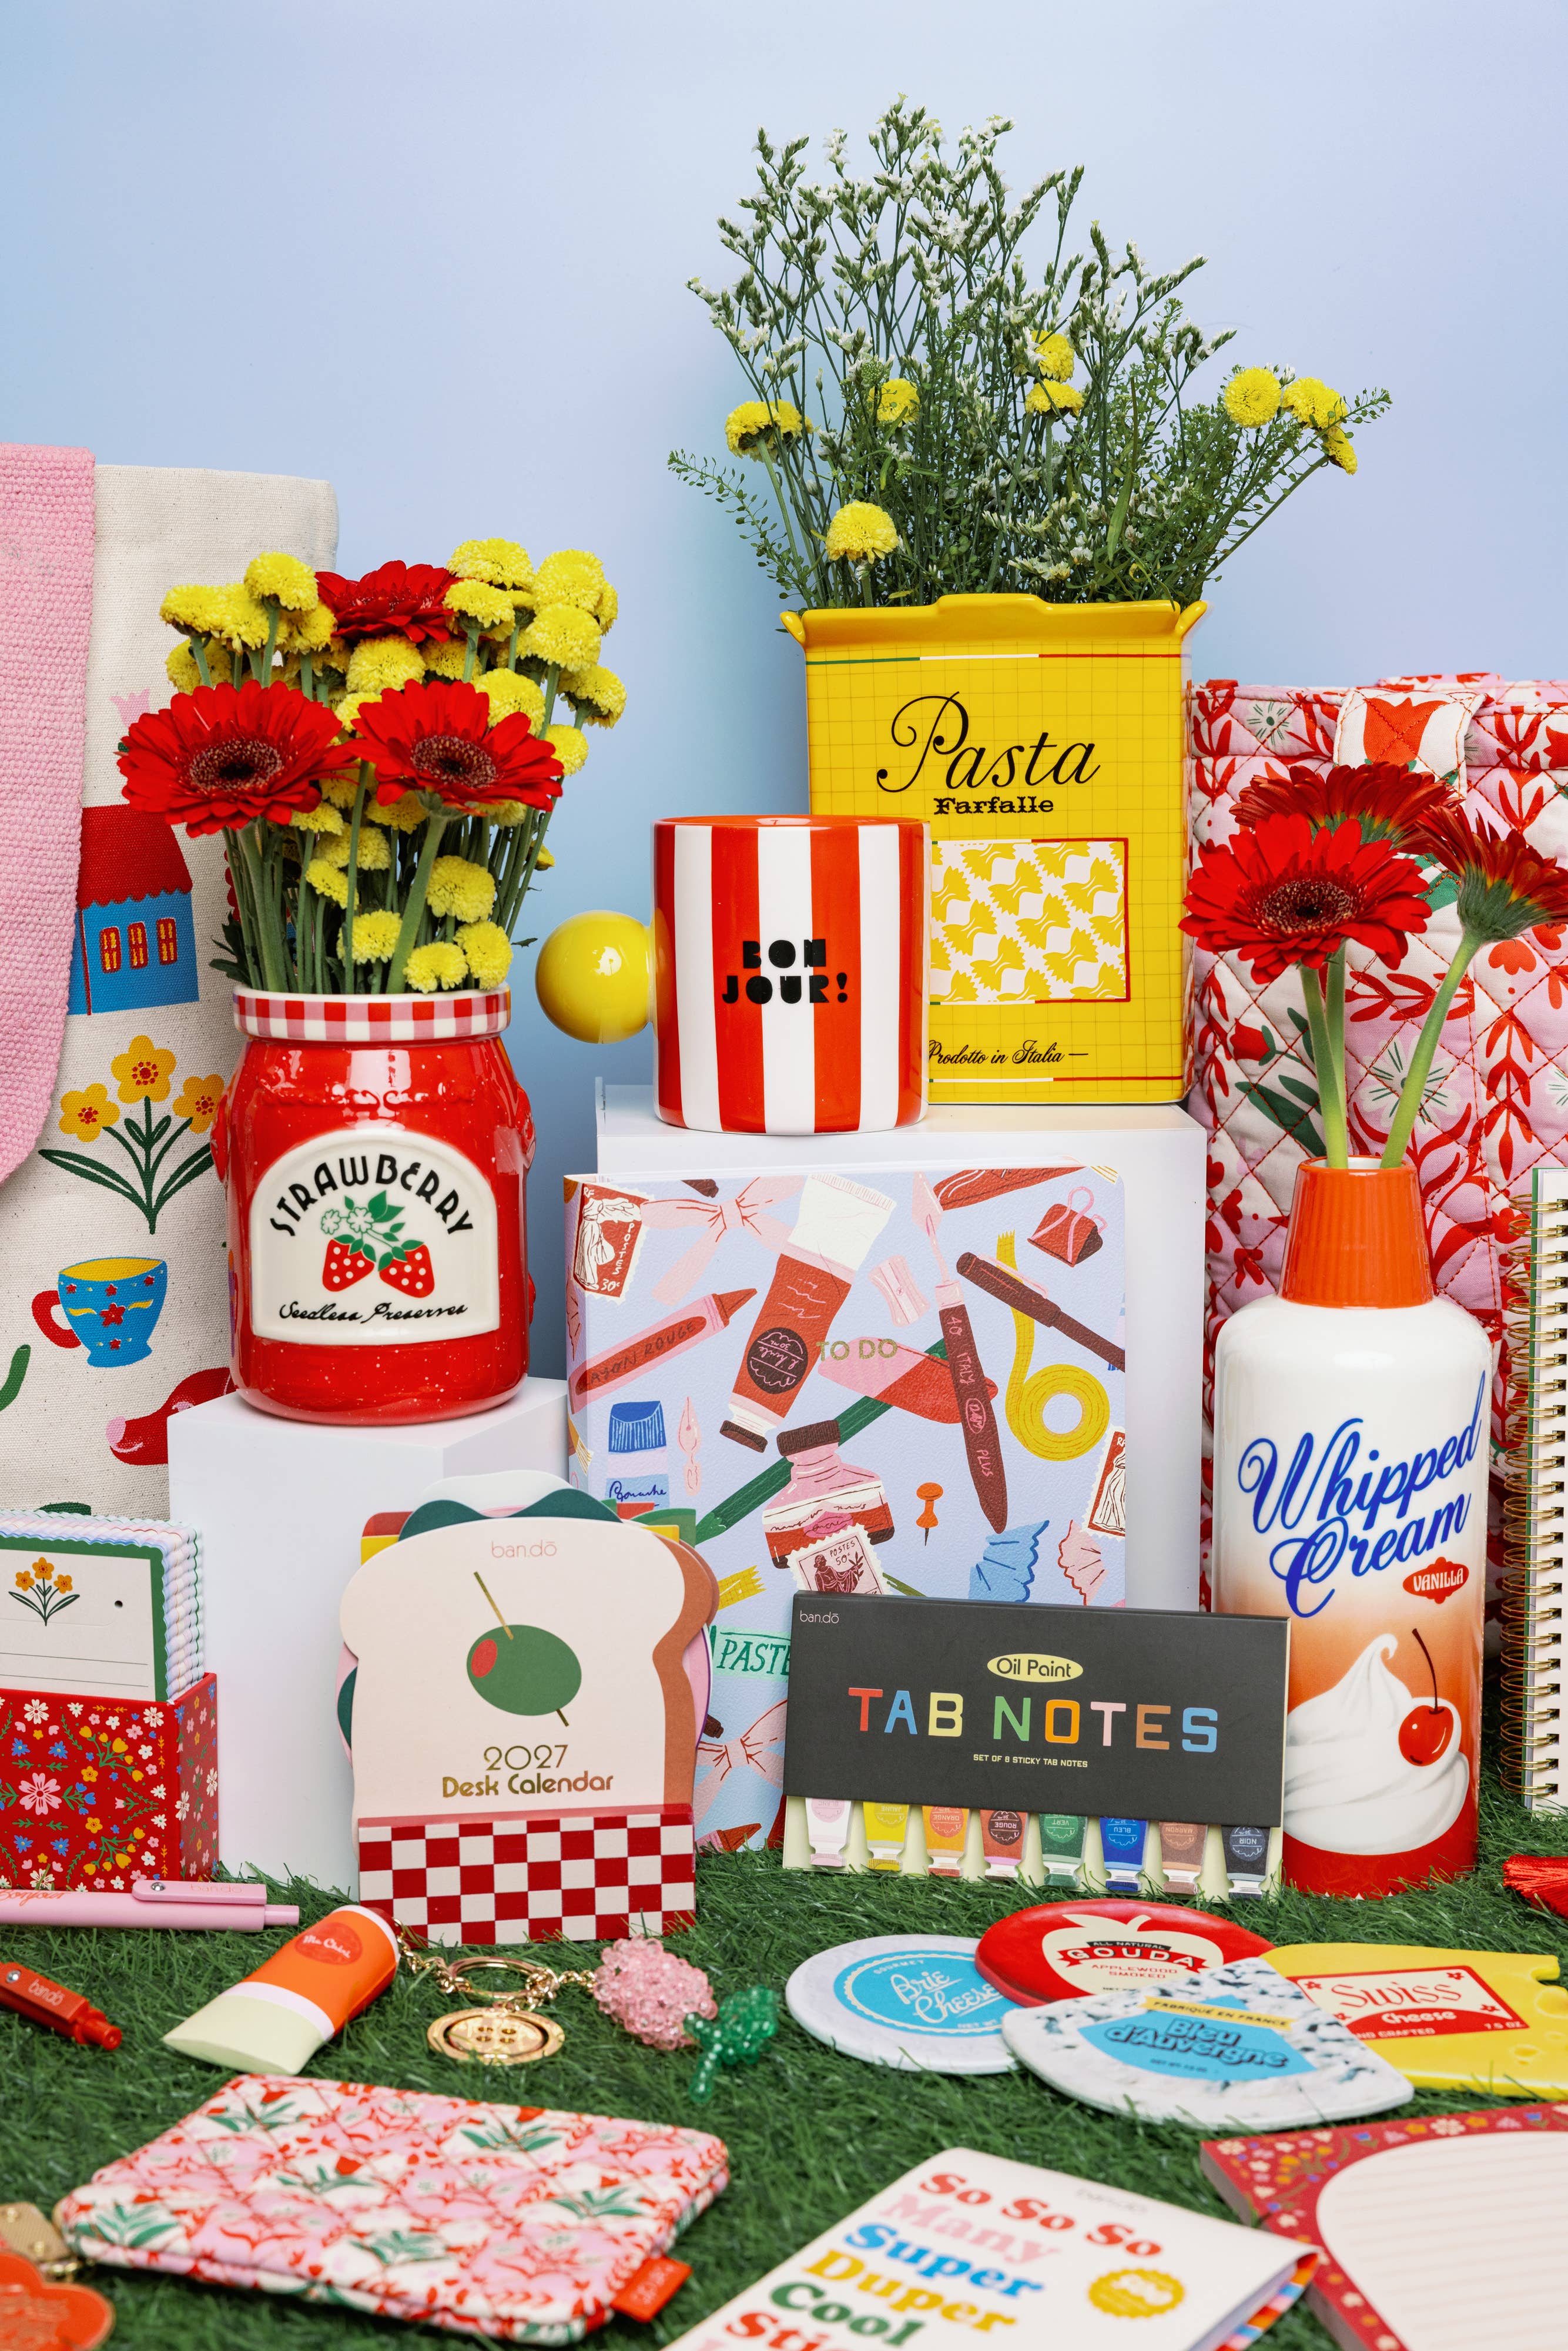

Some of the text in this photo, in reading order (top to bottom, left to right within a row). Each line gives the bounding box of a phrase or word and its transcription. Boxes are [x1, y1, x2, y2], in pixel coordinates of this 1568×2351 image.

[876, 691, 1101, 793] Pasta
[933, 795, 1054, 816] Farfalle
[742, 939, 826, 969] BON
[722, 972, 849, 1004] JOUR!
[928, 1040, 1065, 1064] Prodotto in Italia
[270, 1153, 474, 1237] STRAWBERRY
[584, 1187, 595, 1198] RF
[612, 1223, 635, 1275] POSTES
[279, 1300, 468, 1324] Seedless Preserves
[644, 1321, 696, 1357] ROUGE
[816, 1338, 898, 1361] TO DO
[976, 1448, 994, 1478] PLUS
[1237, 1369, 1486, 1534] Whipped
[829, 1540, 856, 1558] POSTES
[1269, 1492, 1470, 1618] Cream
[1413, 1567, 1464, 1592] VANILLA
[996, 1657, 1071, 1678] Oil Paint
[848, 1687, 1218, 1753] TAB NOTES
[483, 1744, 569, 1770] 2027
[1012, 1756, 1041, 1765] STICKY
[1060, 1759, 1088, 1768] NOTES
[442, 1770, 614, 1799] Desk Calendar
[1066, 1947, 1195, 1967] GOUDA
[1116, 1941, 1166, 1950] NATURAL
[1091, 1964, 1178, 1974] APPLEWOOD
[1108, 1971, 1166, 1979] SMOKED
[890, 1971, 950, 2005] Brie
[1331, 1981, 1462, 2008] Swiss
[912, 1983, 1001, 2024] Cheese
[1381, 2011, 1458, 2025] Cheese
[1165, 2017, 1242, 2047] Bleu
[1238, 2014, 1287, 2027] FRANCE
[1379, 2027, 1436, 2039] CRAFTED
[1104, 2023, 1289, 2068] d'Auvergne
[879, 2192, 1061, 2265] Many
[919, 2172, 992, 2206] So
[1000, 2197, 1075, 2231] So
[1085, 2222, 1162, 2257] So
[843, 2222, 1044, 2299] Super
[801, 2249, 1018, 2333] Duper
[769, 2280, 927, 2347] Cool
